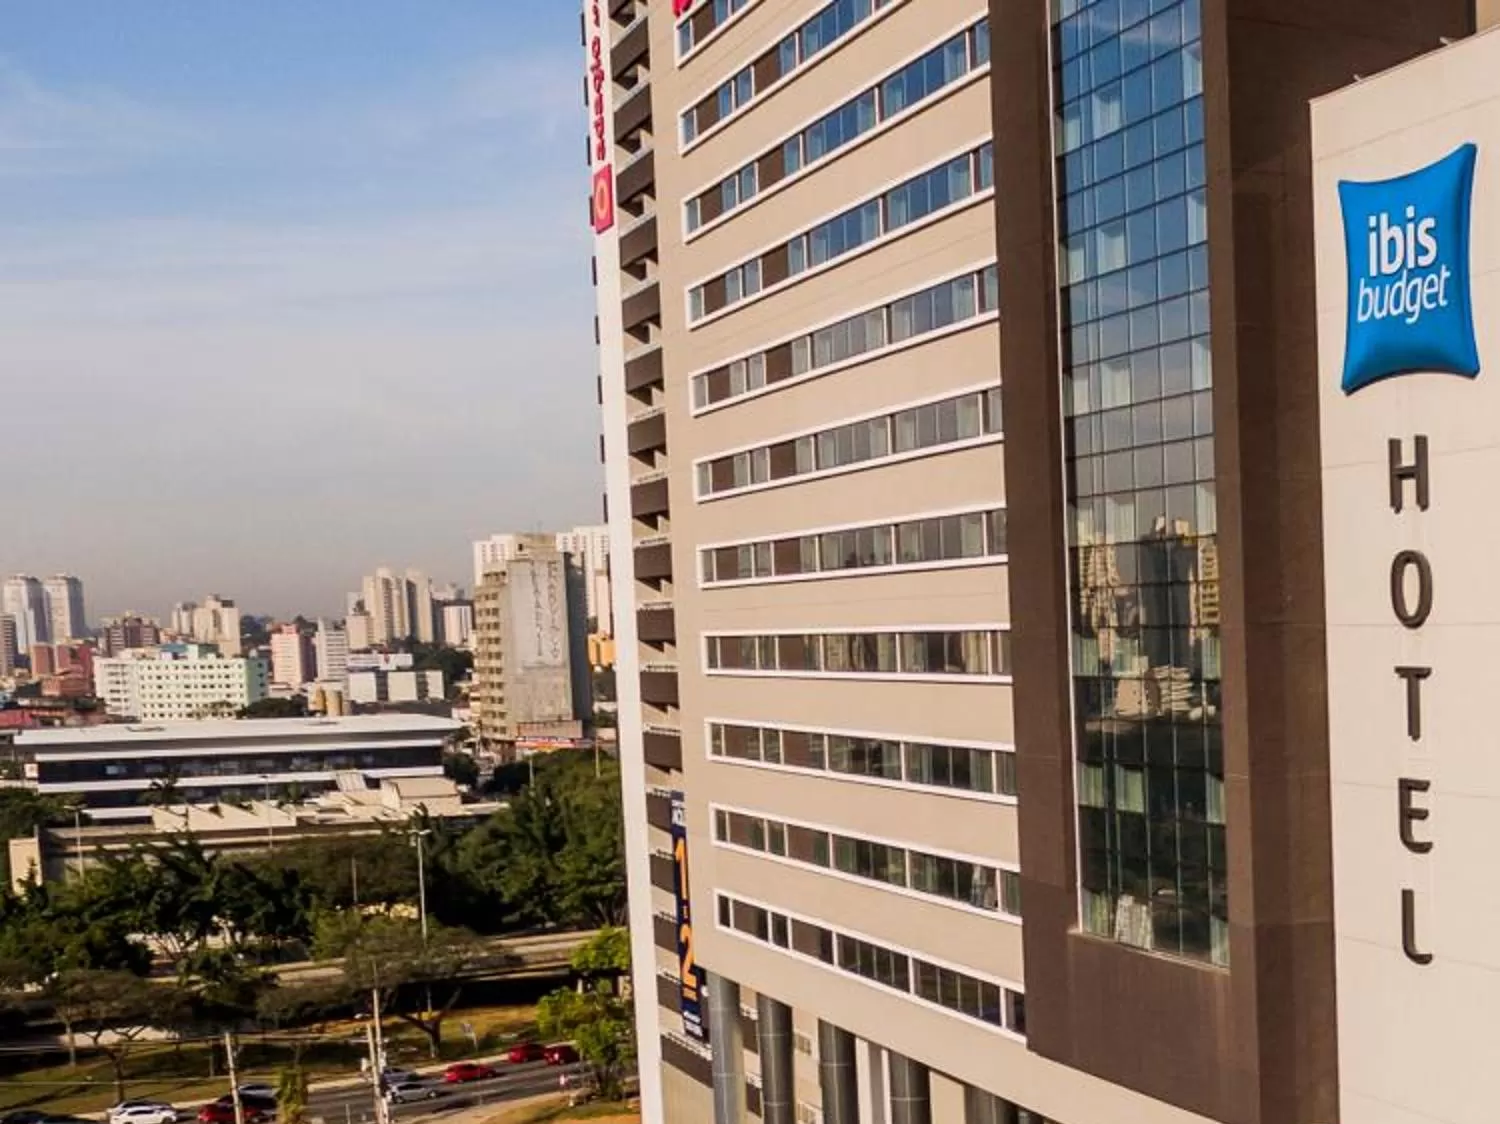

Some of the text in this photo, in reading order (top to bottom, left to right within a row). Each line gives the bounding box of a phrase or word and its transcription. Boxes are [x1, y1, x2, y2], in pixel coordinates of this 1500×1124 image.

[1368, 205, 1438, 277] ibis
[1357, 264, 1451, 324] budget
[1388, 435, 1433, 965] HOTEL
